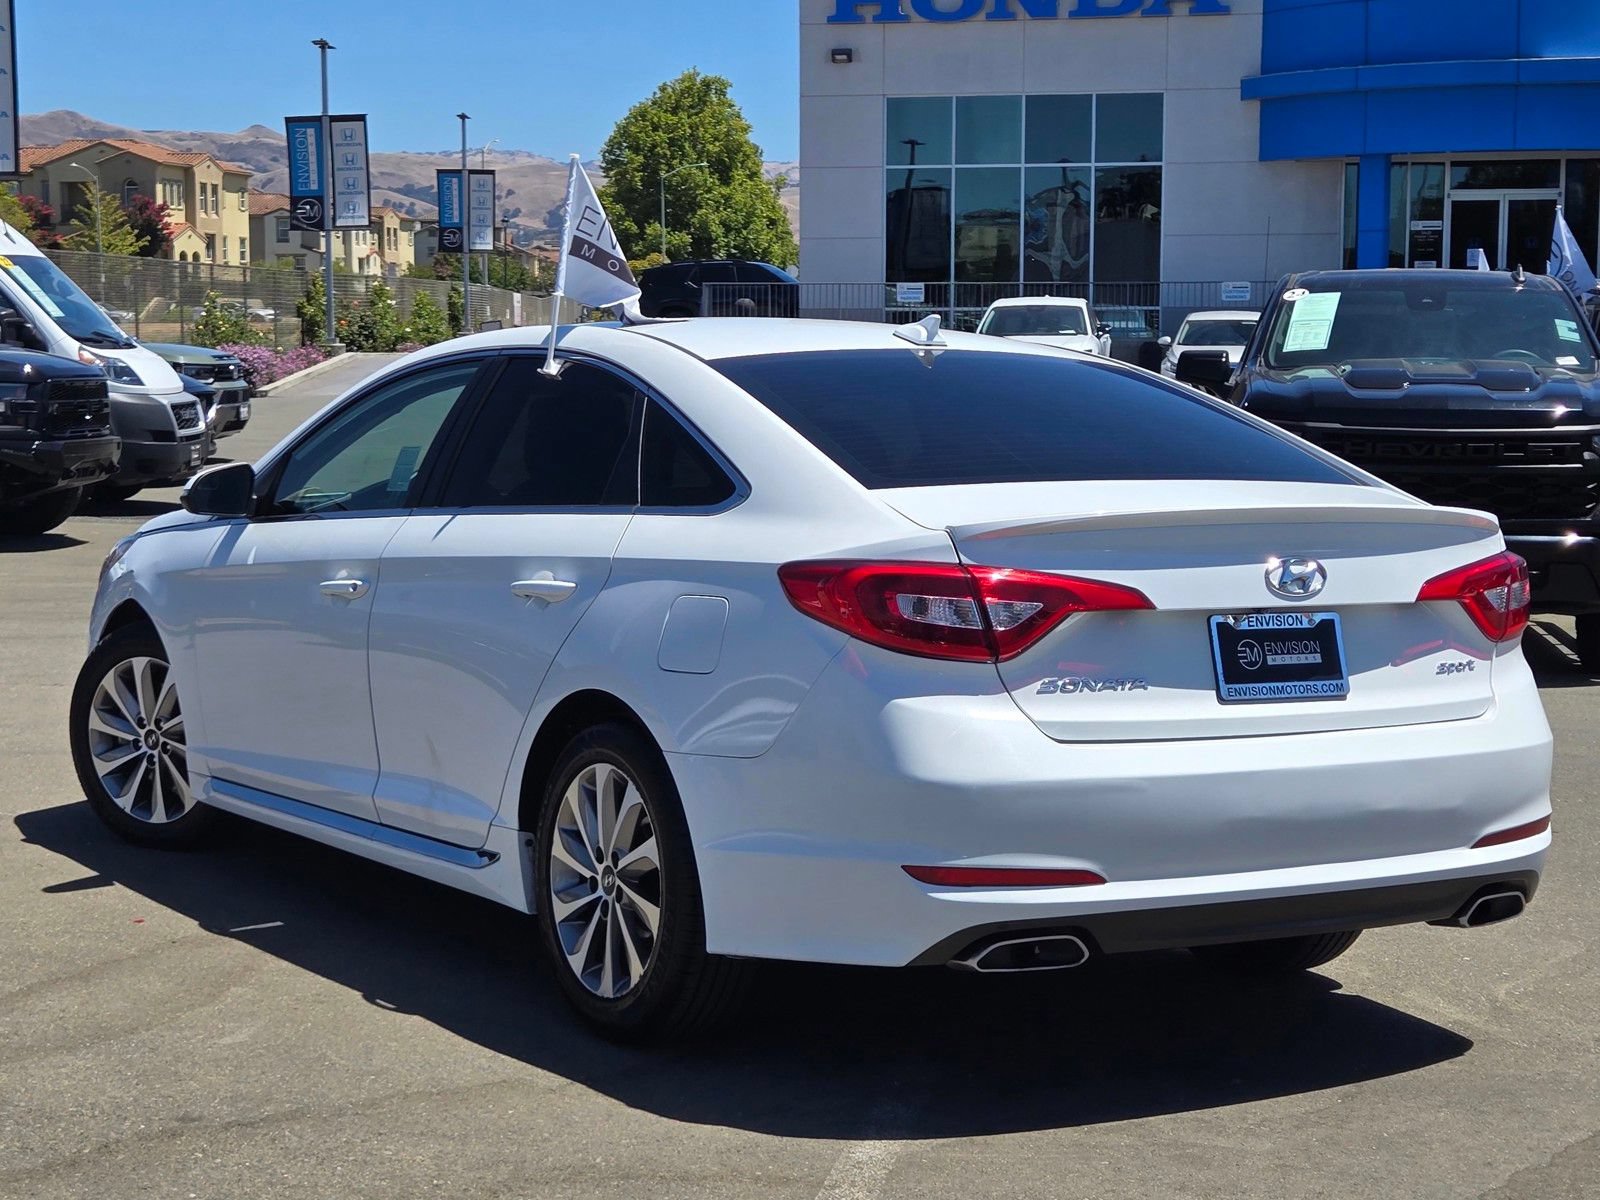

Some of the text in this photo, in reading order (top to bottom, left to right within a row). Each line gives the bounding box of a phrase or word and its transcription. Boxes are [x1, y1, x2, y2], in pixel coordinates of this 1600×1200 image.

[294, 127, 310, 191] ENVISION
[1247, 614, 1303, 628] ENVISION
[1263, 640, 1321, 655] ENVISION
[1271, 655, 1318, 663] MOTORS
[1435, 659, 1476, 675] Sport
[1036, 676, 1149, 695] SONATA
[1227, 682, 1345, 697] ENVISIONMOTORS.COM
